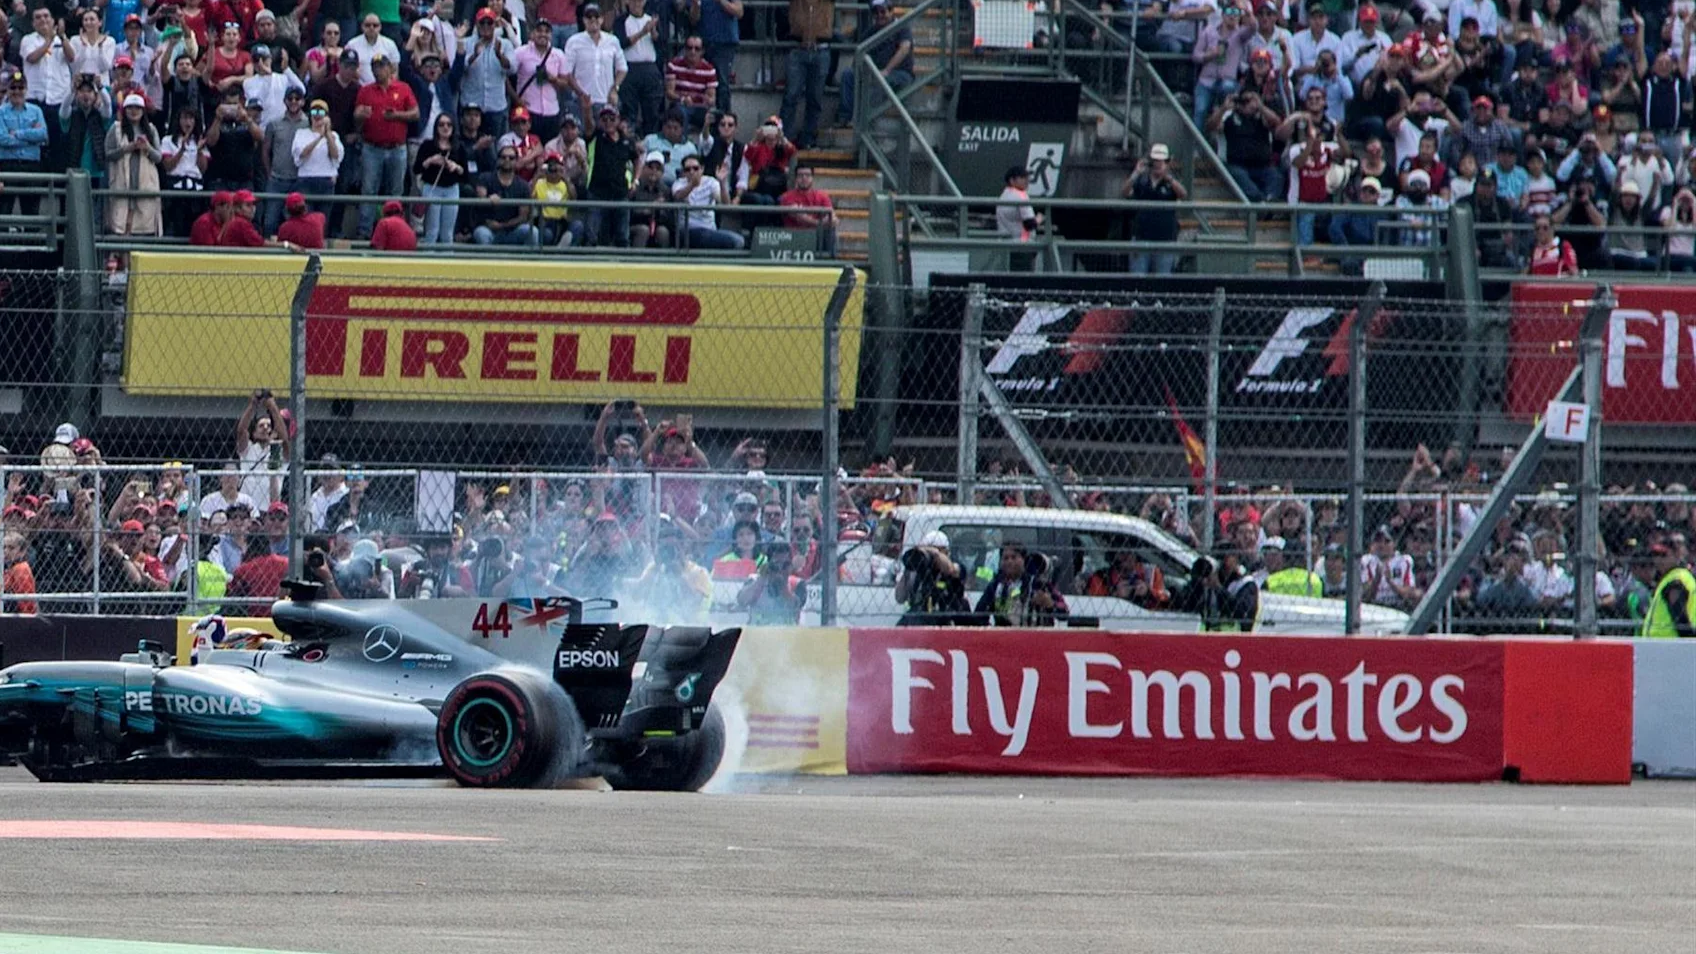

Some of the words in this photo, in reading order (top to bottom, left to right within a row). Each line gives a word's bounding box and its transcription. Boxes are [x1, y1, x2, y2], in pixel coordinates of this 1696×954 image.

[958, 142, 980, 152] EXIT
[960, 125, 1020, 143] SALIDA
[306, 285, 701, 383] PIRELLI
[1607, 309, 1696, 389] Fl
[994, 377, 1045, 390] rmula
[1235, 378, 1306, 393] Formula
[1565, 408, 1584, 435] F
[472, 602, 513, 639] 44
[558, 650, 620, 669] EPSON
[125, 690, 263, 716] PETRONAS
[887, 648, 1039, 756] Fly
[1065, 649, 1468, 744] Emirates
